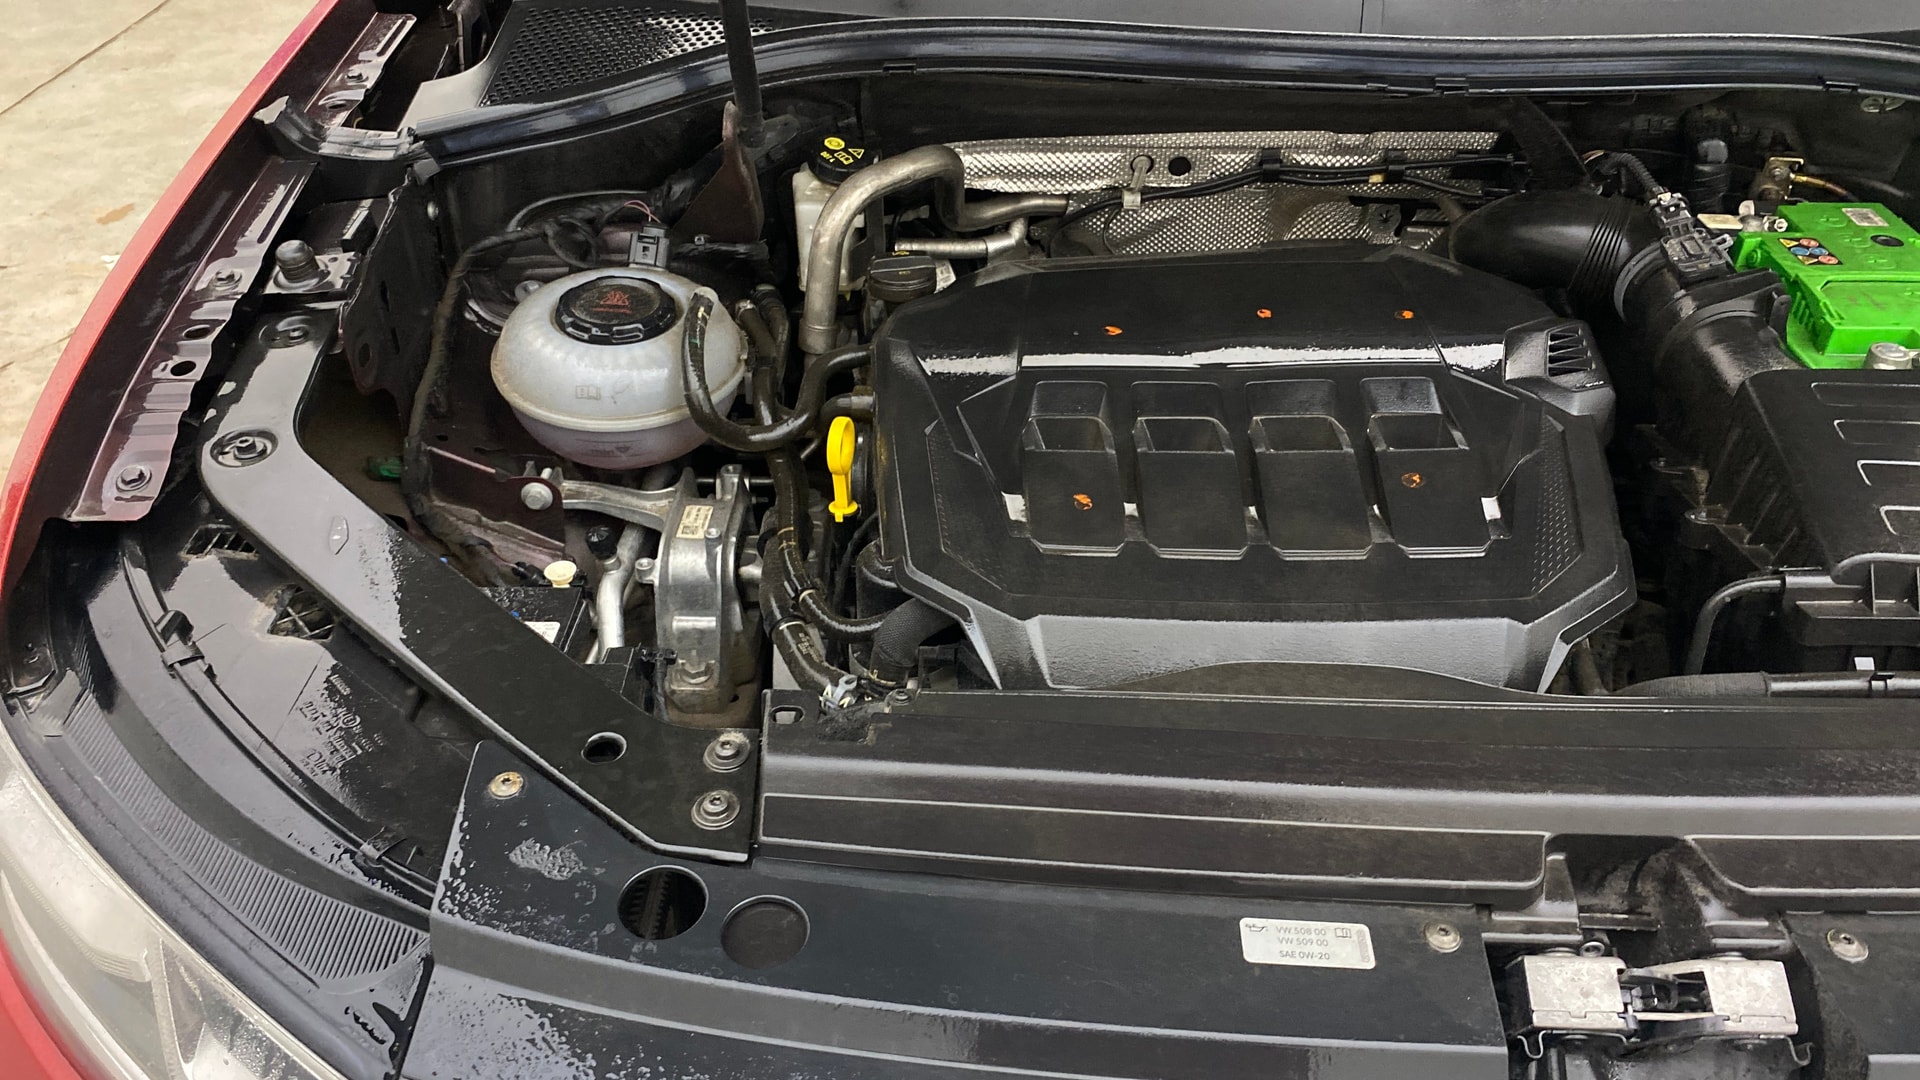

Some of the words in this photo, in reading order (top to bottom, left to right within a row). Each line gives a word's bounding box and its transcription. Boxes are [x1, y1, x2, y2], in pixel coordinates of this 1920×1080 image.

[1275, 925, 1292, 934] VW
[1294, 927, 1313, 936] 508
[1314, 928, 1327, 936] 00
[1278, 937, 1294, 945] VW
[1296, 937, 1314, 946] 509
[1316, 938, 1329, 947] 00
[1279, 950, 1297, 959] SAE
